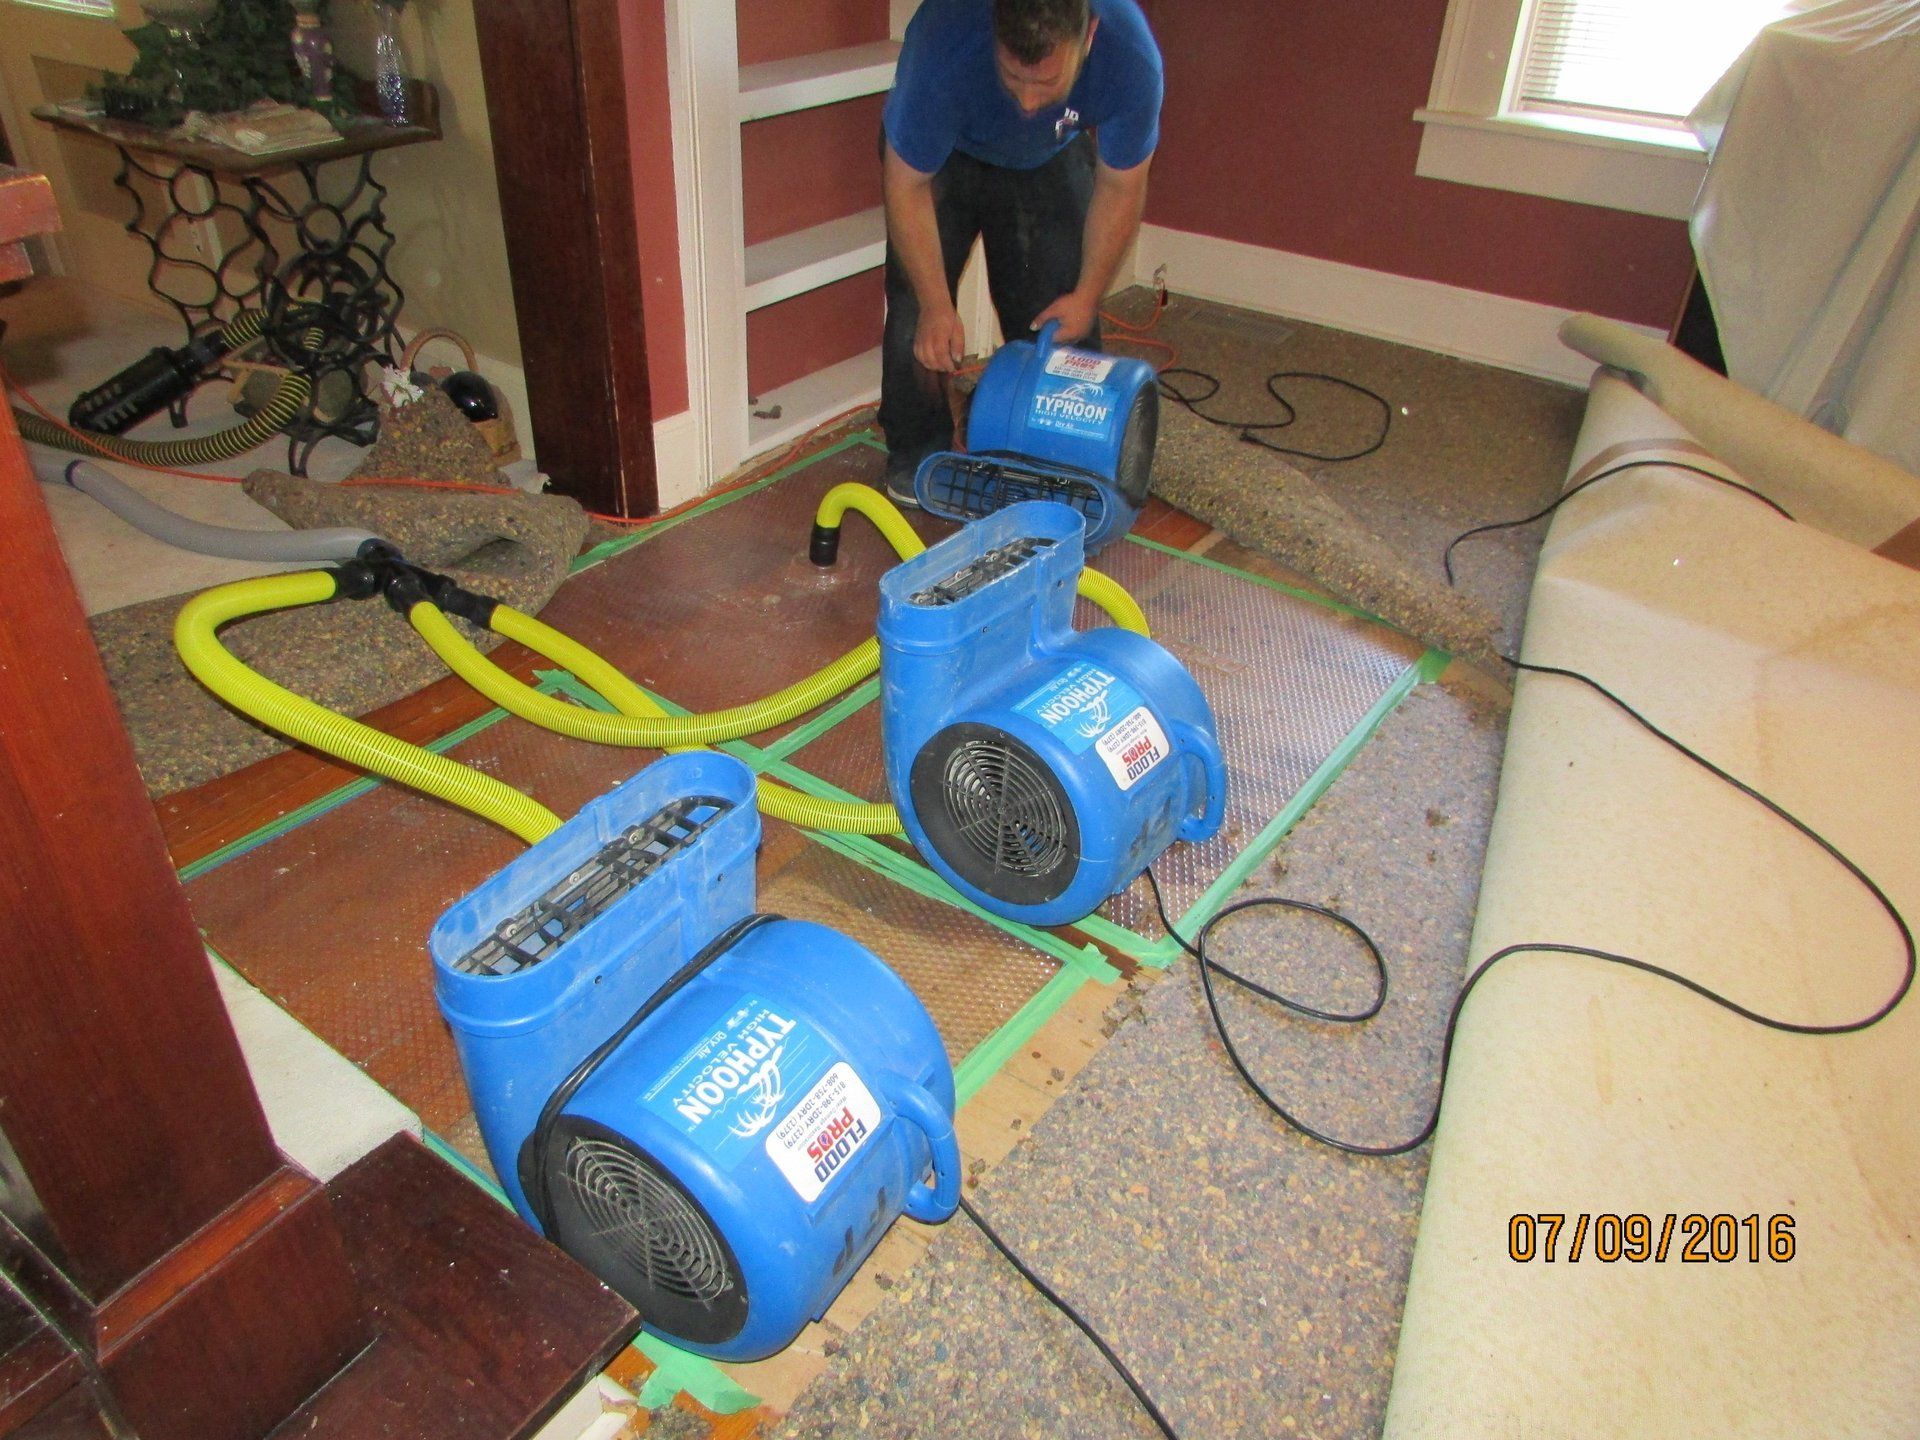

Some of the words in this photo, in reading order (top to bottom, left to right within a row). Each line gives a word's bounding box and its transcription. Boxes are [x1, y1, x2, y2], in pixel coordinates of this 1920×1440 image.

[1035, 395, 1107, 421] TYPHOON
[1040, 670, 1116, 725] TYPHOON
[1122, 736, 1152, 767] PROS
[1127, 746, 1160, 781] FLOOD
[737, 1009, 770, 1040] HIGH
[673, 1042, 738, 1106] VELOCITY
[677, 1013, 797, 1125] TYPHOON
[806, 1106, 854, 1163] PROS
[814, 1118, 867, 1183] FLOOD
